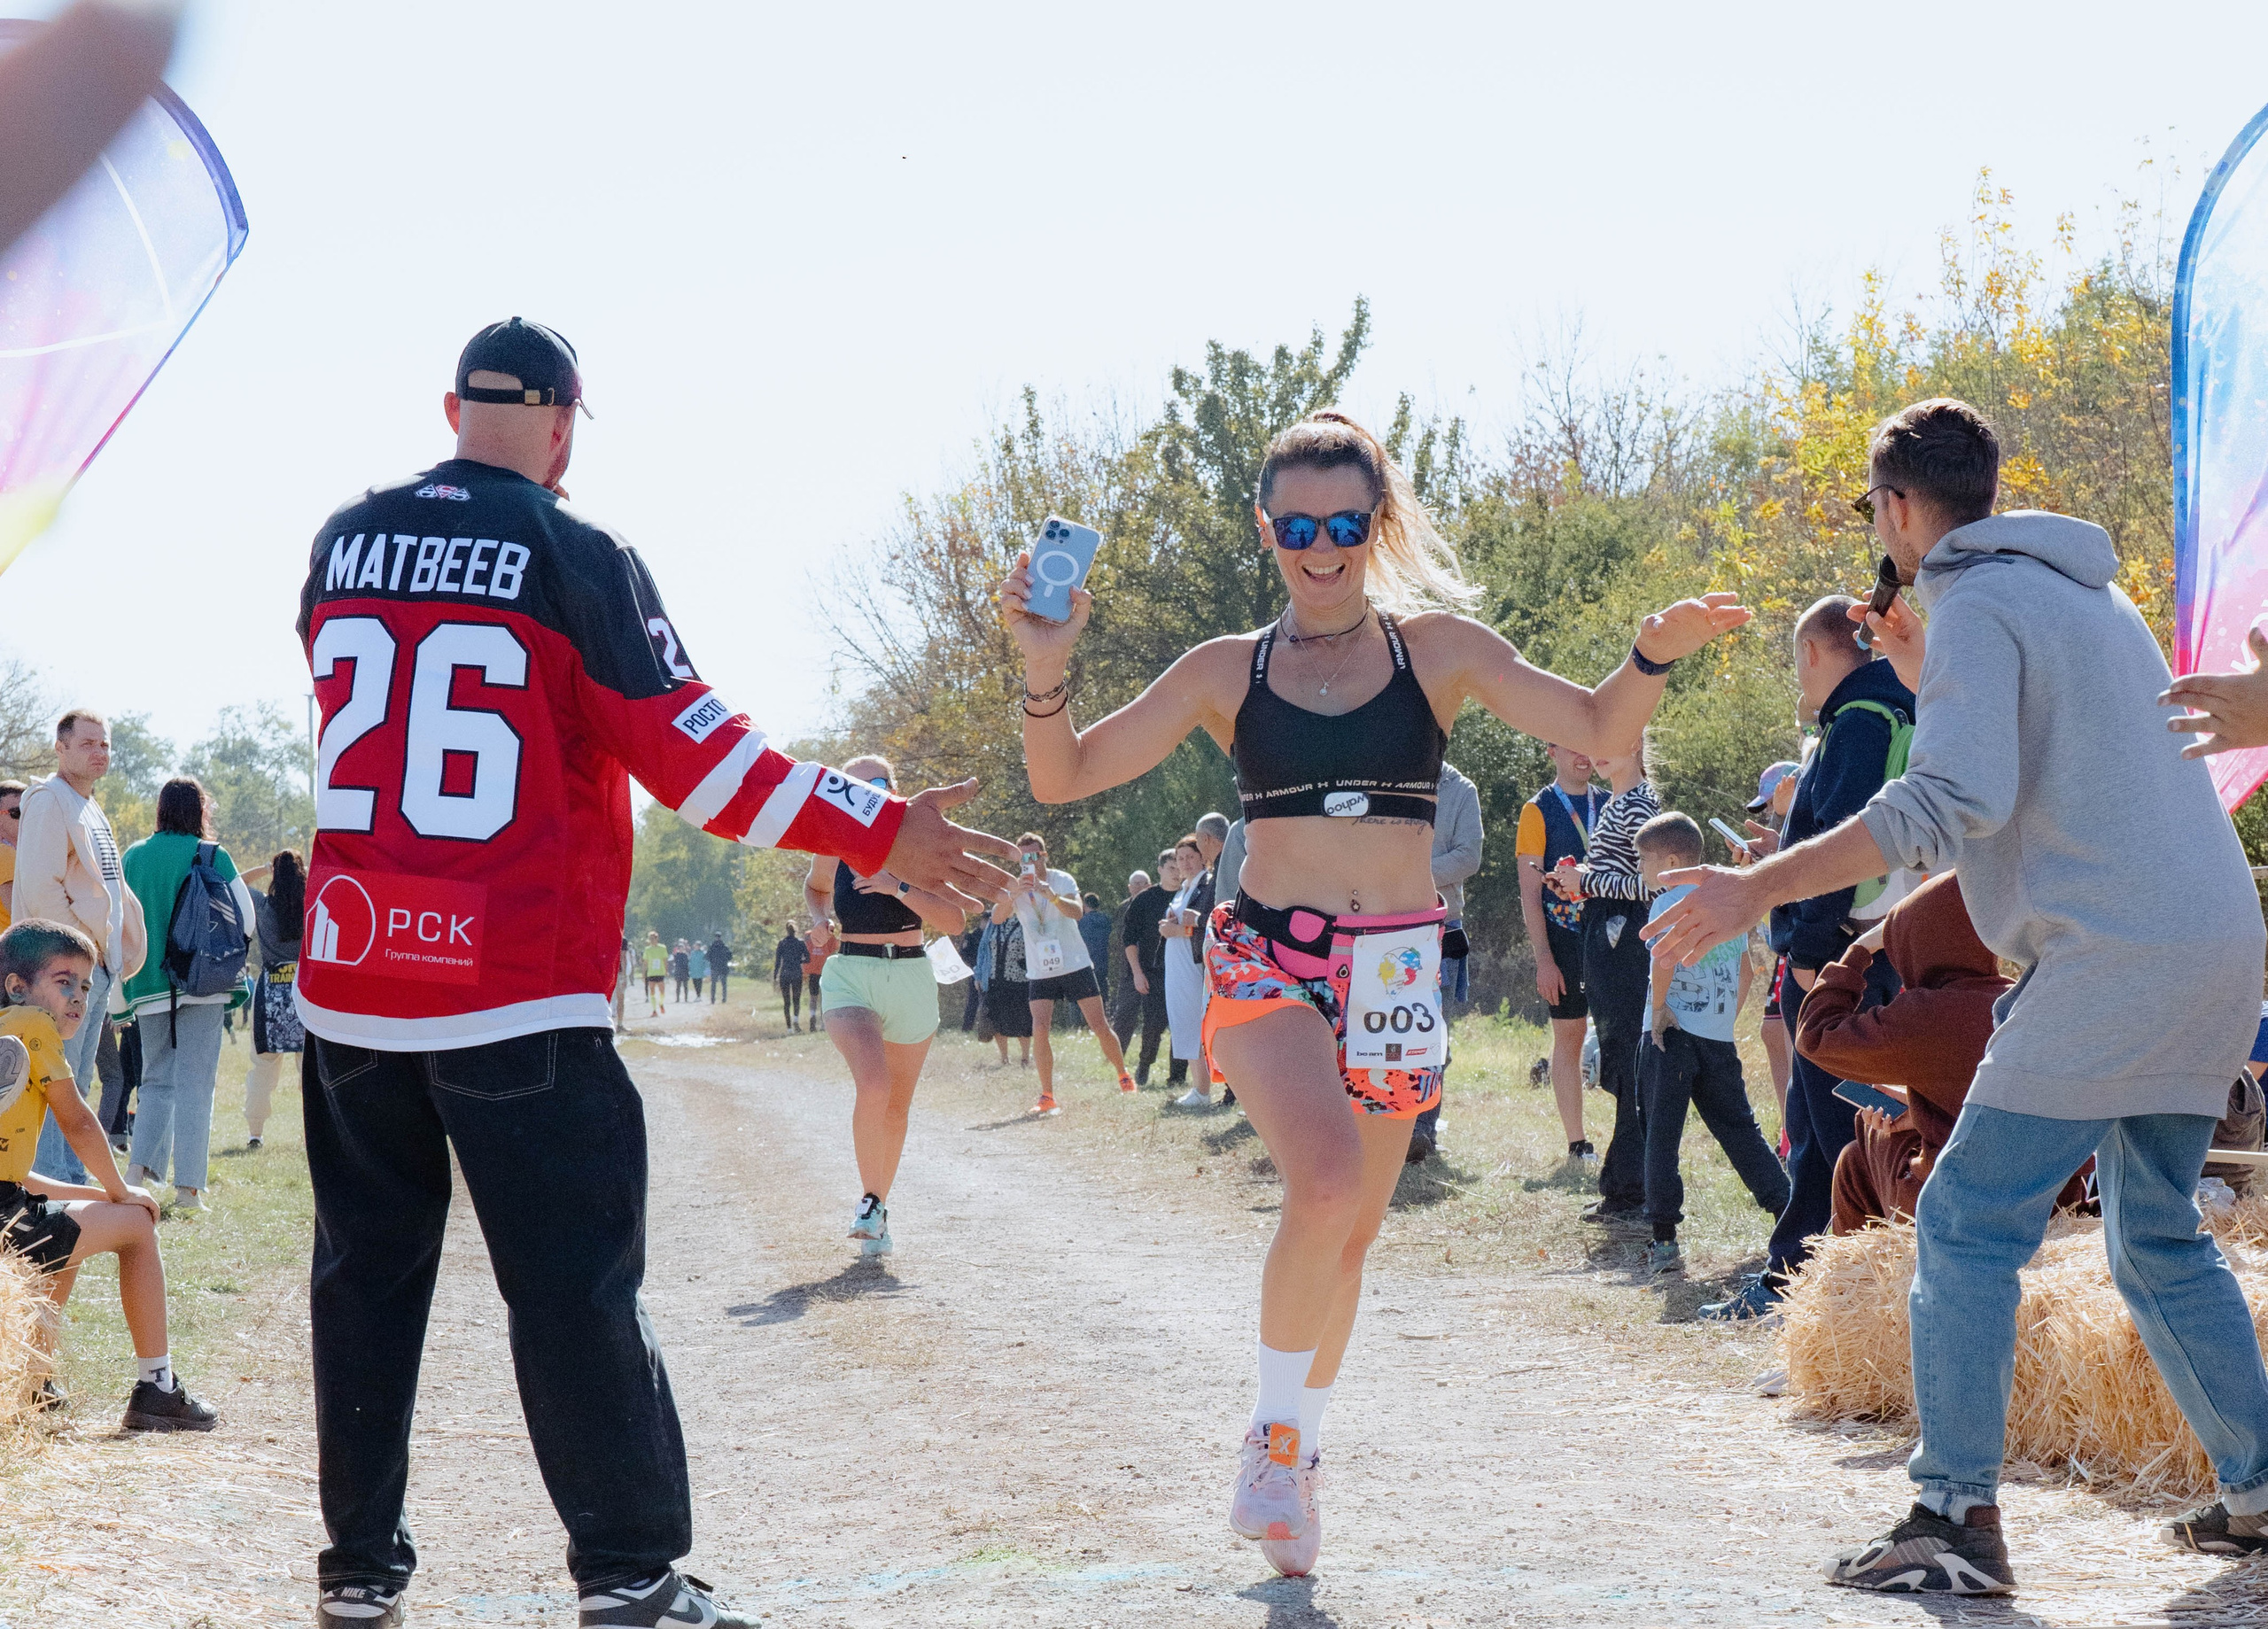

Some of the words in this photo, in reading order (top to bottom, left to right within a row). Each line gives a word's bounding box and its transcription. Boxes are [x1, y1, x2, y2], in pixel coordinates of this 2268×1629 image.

[325, 532, 532, 601] МАТВЕЕВ
[1255, 640, 1270, 671] UNDER
[313, 615, 531, 843] 26
[682, 698, 728, 734] РОСТО
[1265, 783, 1313, 798] ARMOUR
[1326, 793, 1370, 815] wahoo
[387, 908, 475, 946] РСК
[384, 948, 421, 962] Группа
[422, 954, 474, 966] компаний
[1043, 957, 1060, 966] 049
[1363, 1002, 1435, 1035] 003
[340, 1586, 367, 1599] NIKE
